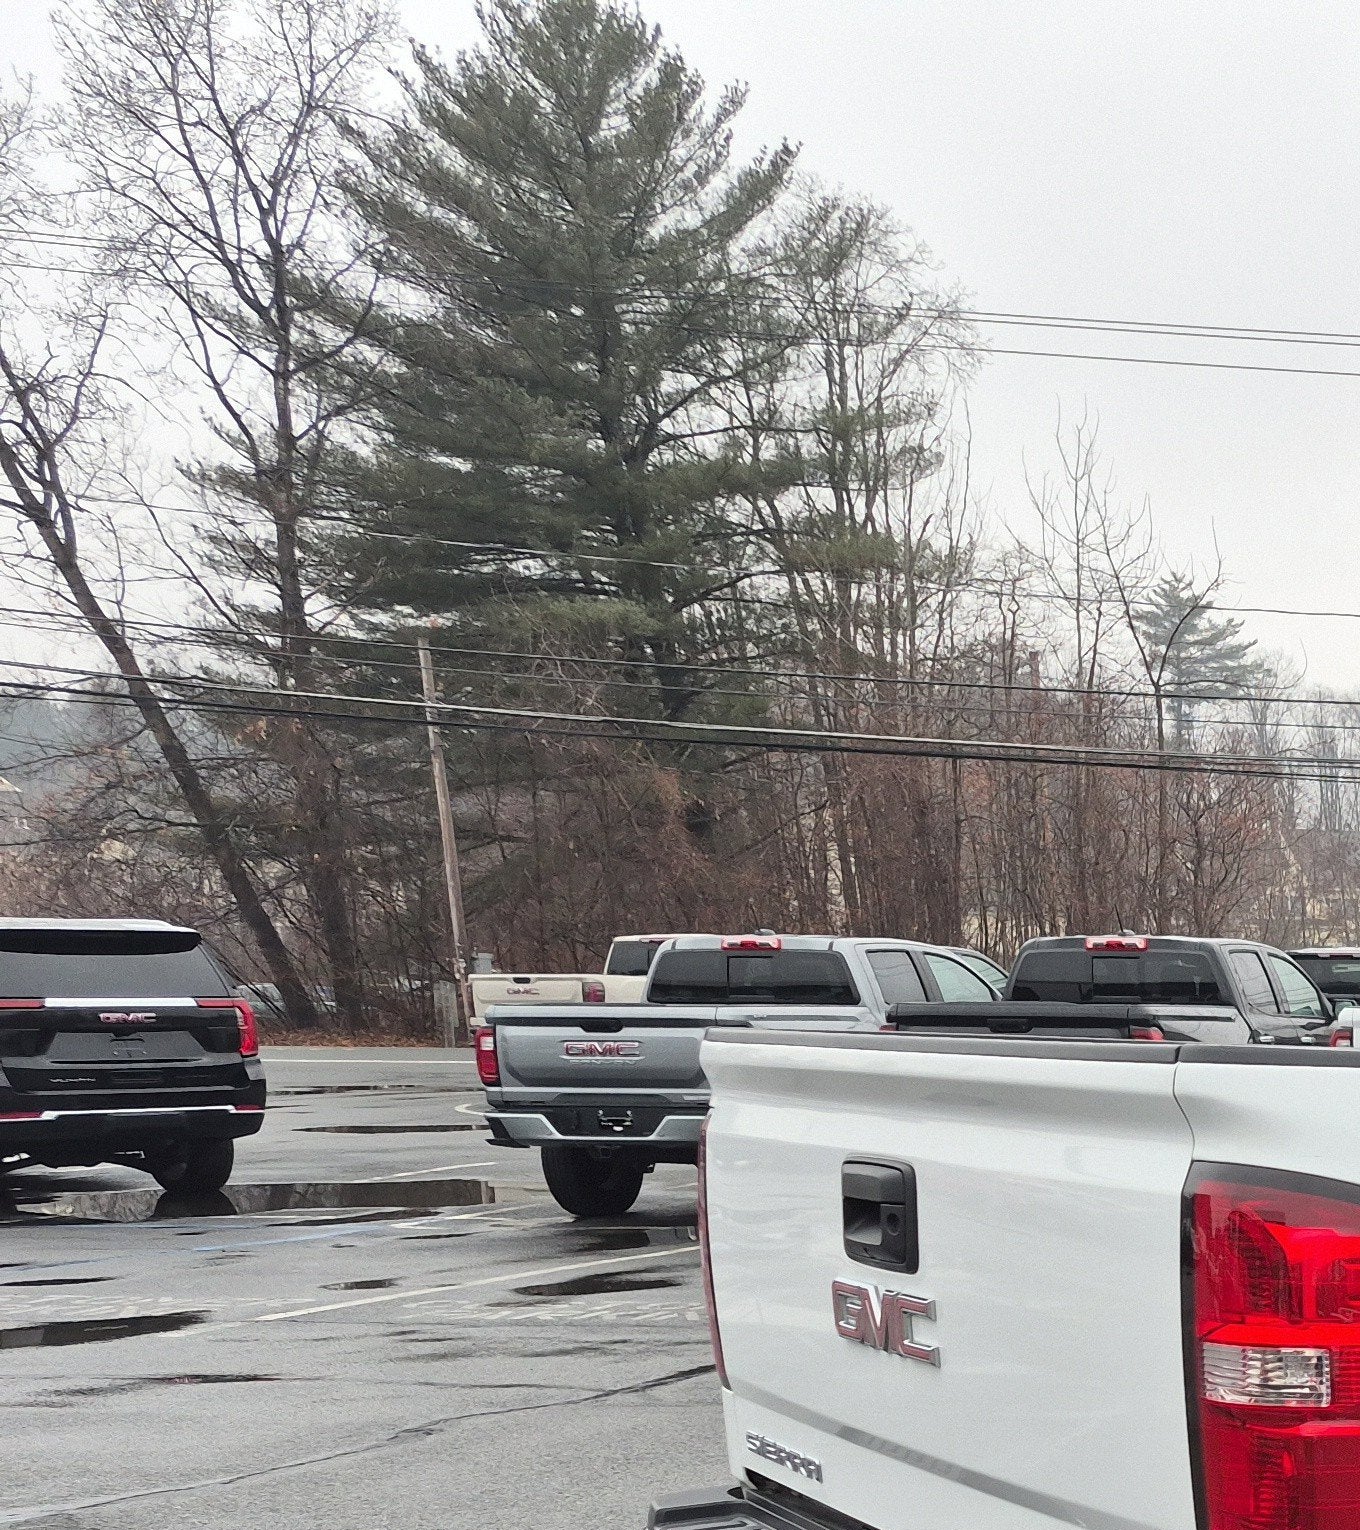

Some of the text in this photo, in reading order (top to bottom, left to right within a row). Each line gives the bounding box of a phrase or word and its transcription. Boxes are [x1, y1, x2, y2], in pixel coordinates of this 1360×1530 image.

[506, 987, 540, 995] GMC
[99, 1012, 157, 1024] GMC
[562, 1041, 641, 1056] GMC
[831, 1279, 942, 1369] GMC
[745, 1430, 823, 1484] SIERRA
